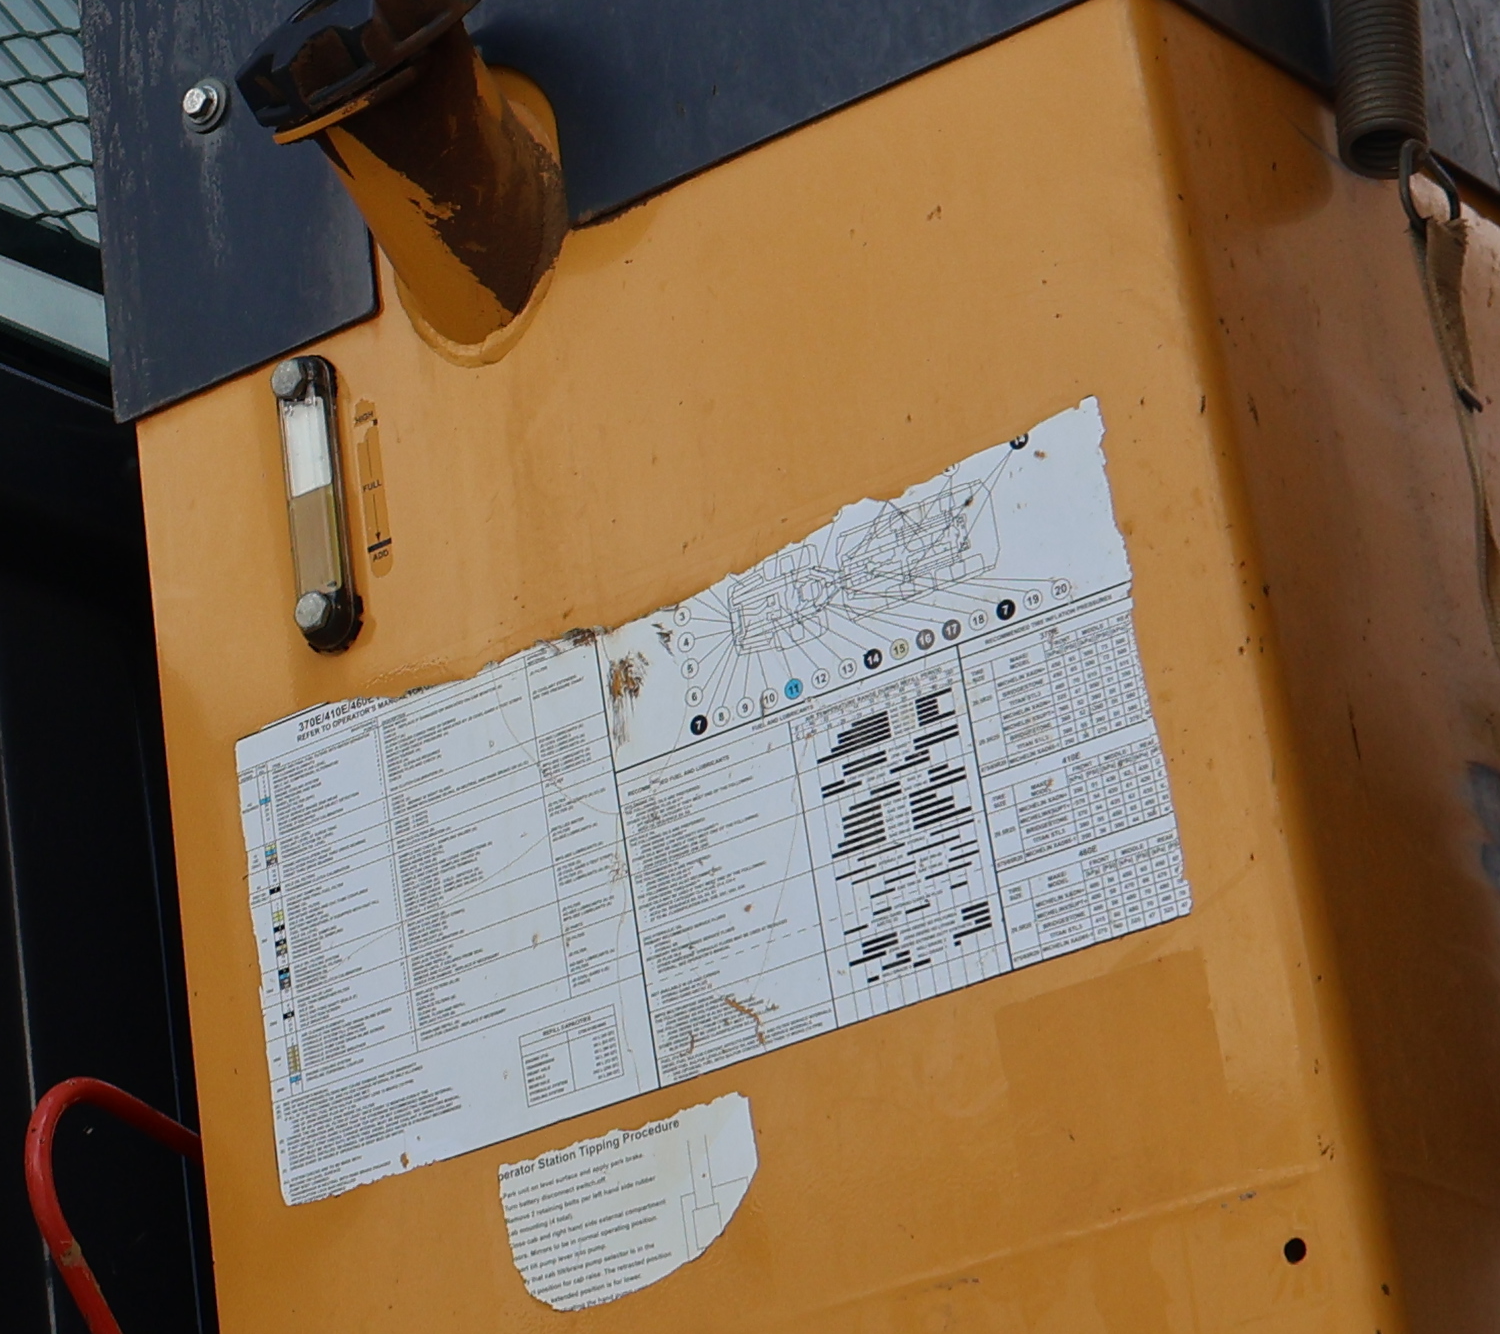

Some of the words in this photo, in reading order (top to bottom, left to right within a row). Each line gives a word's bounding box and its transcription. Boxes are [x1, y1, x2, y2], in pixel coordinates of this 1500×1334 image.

[362, 479, 383, 493] FULL
[372, 550, 390, 563] ADD
[679, 611, 685, 620] 3
[682, 637, 689, 646] 4
[695, 719, 702, 730] 7
[717, 711, 724, 721] 8
[741, 702, 748, 712] 9
[763, 692, 775, 704] 10
[788, 683, 799, 695] 11
[814, 673, 826, 685] 12
[841, 663, 853, 675] 13
[867, 653, 879, 665] 14
[893, 642, 906, 655] 15
[919, 633, 932, 645] 16
[945, 623, 958, 635] 17
[971, 613, 984, 625] 18
[1001, 604, 1009, 615] 7
[1026, 593, 1039, 605] 19
[1053, 582, 1067, 595] 20
[687, 663, 693, 673] 5
[690, 691, 697, 701] 6
[296, 727, 320, 742] REFER
[321, 722, 331, 732] TO
[537, 1151, 576, 1170] Station
[578, 1137, 620, 1157] Tipping
[622, 1117, 679, 1144] Procedure
[539, 1179, 554, 1188] level
[555, 1173, 578, 1184] surface
[518, 1198, 540, 1208] battery
[541, 1186, 575, 1201] disconnect
[536, 1203, 563, 1215] retaining
[564, 1198, 580, 1207] bolts
[603, 1186, 619, 1195] hand
[552, 1228, 567, 1237] right
[567, 1223, 583, 1232] hand
[598, 1211, 624, 1224] external
[625, 1198, 666, 1216] compartment
[519, 1221, 548, 1234] mounting
[530, 1246, 552, 1257] Mirrors
[577, 1231, 599, 1243] normal
[600, 1223, 630, 1236] operating
[539, 1258, 557, 1269] pump
[557, 1253, 573, 1262] lever
[585, 1258, 602, 1269] pump
[603, 1250, 629, 1262] selector
[537, 1283, 562, 1295] position
[617, 1258, 645, 1271] retracted
[646, 1251, 672, 1264] position
[550, 1290, 579, 1303] extended
[580, 1283, 605, 1296] position
